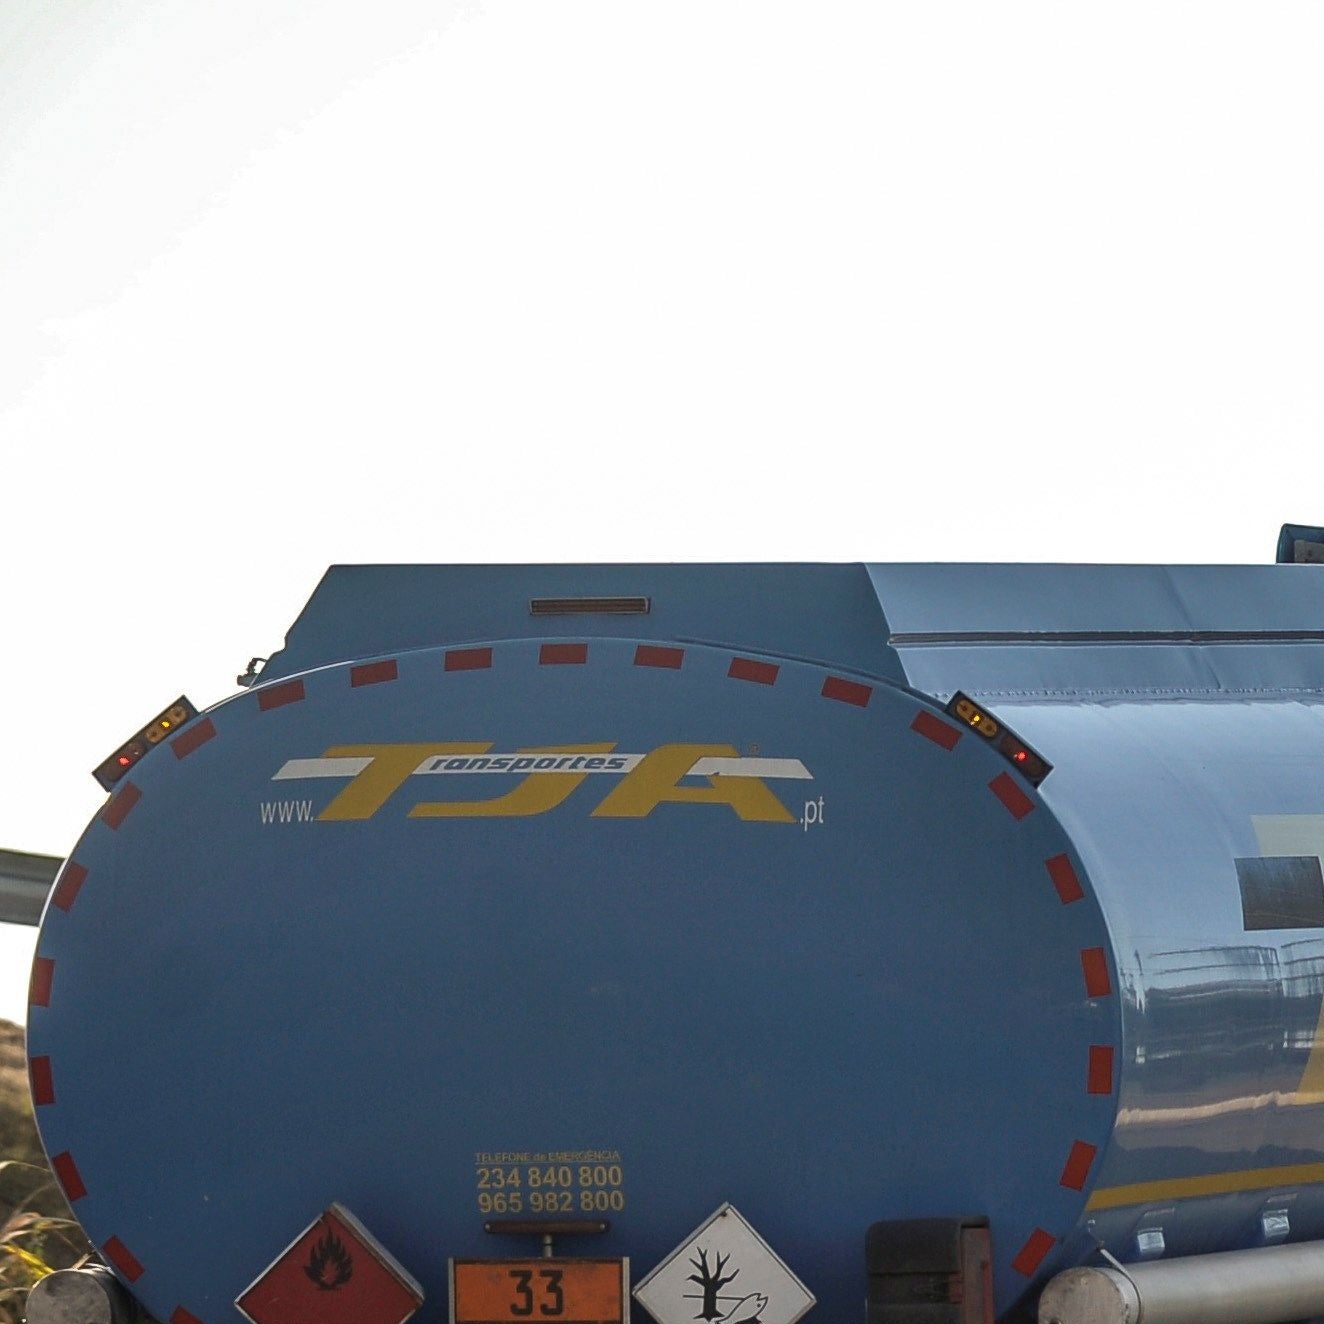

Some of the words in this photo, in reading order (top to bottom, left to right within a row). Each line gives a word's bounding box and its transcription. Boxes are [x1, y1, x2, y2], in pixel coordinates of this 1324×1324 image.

[260, 800, 314, 824] www.
[475, 1152, 530, 1162] TELEFONE
[476, 1167, 521, 1189] 234
[528, 1166, 572, 1188] 840
[579, 1165, 623, 1187] 800
[478, 1191, 523, 1213] 965
[530, 1191, 573, 1212] 982
[580, 1190, 625, 1211] 800
[508, 1269, 564, 1316] 33
